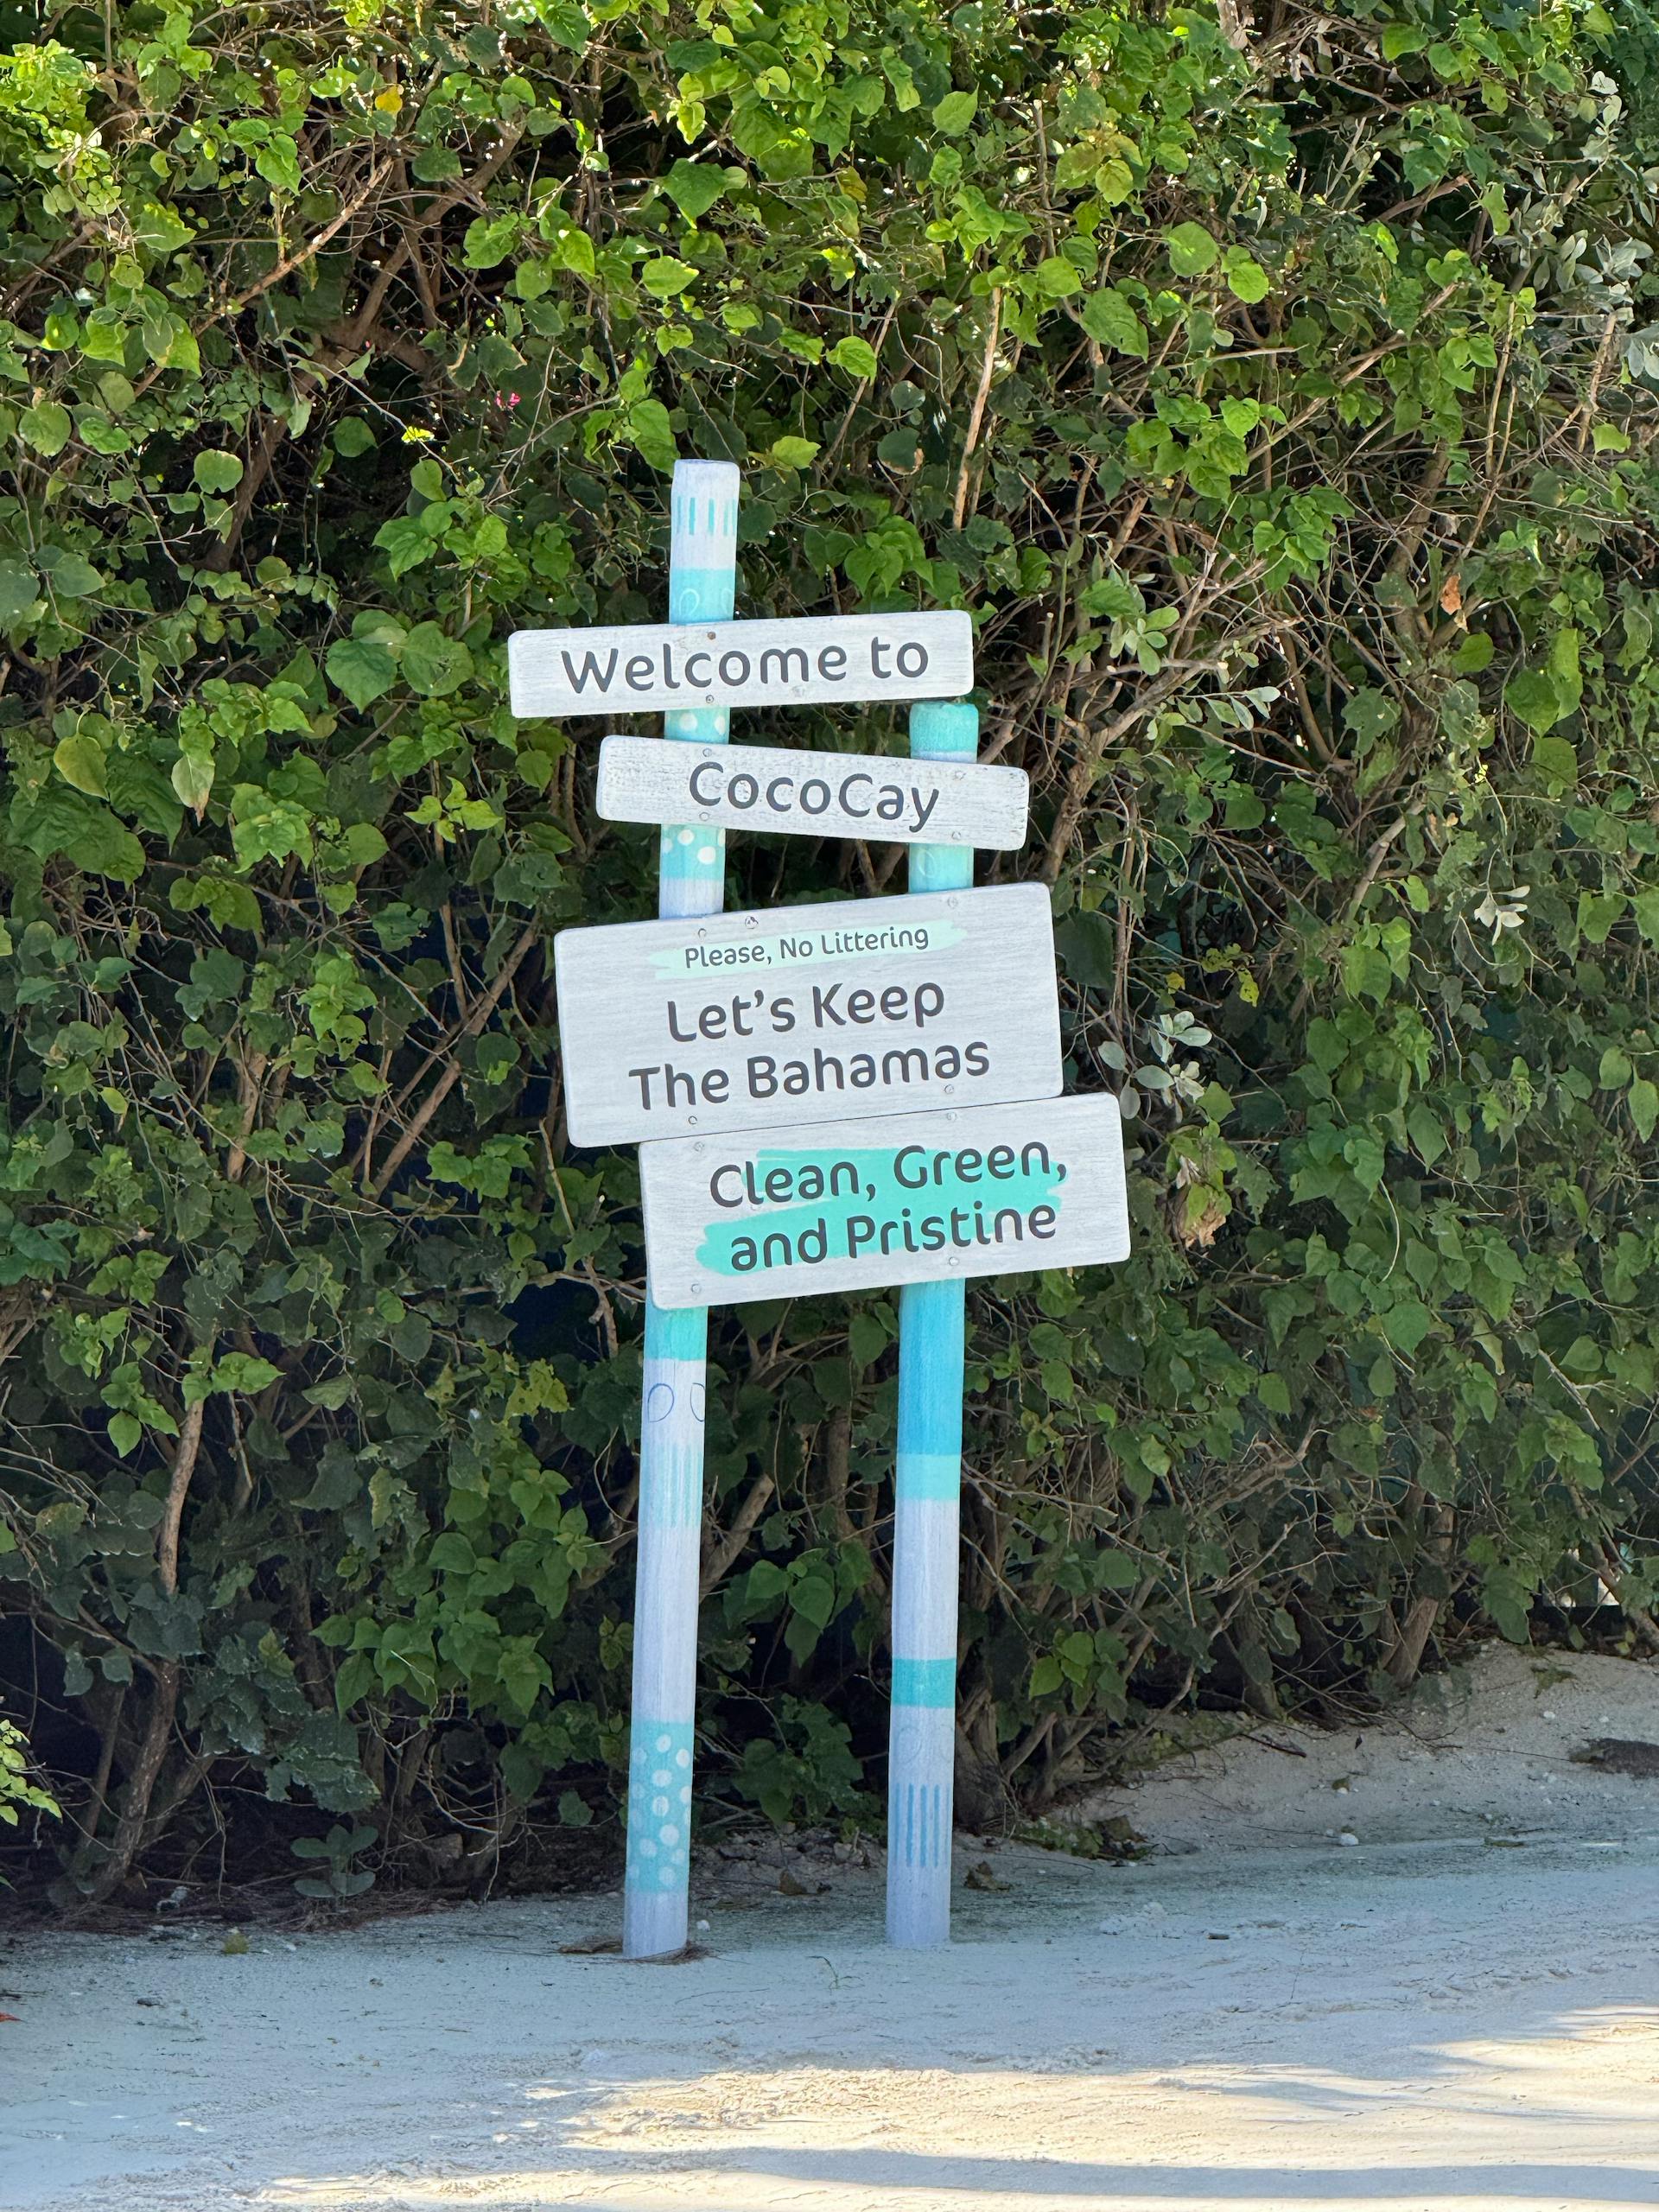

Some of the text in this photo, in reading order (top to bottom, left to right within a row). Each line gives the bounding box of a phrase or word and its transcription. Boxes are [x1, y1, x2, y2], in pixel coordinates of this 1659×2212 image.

[561, 635, 929, 694] Welcome to
[689, 761, 939, 833] CocoCay
[684, 927, 929, 969] Please, No Littering
[667, 981, 944, 1043] Let’s Keep
[628, 1039, 989, 1110] The Bahamas
[709, 1141, 1067, 1208] Clean, Green,
[730, 1203, 1057, 1271] and Pristine
